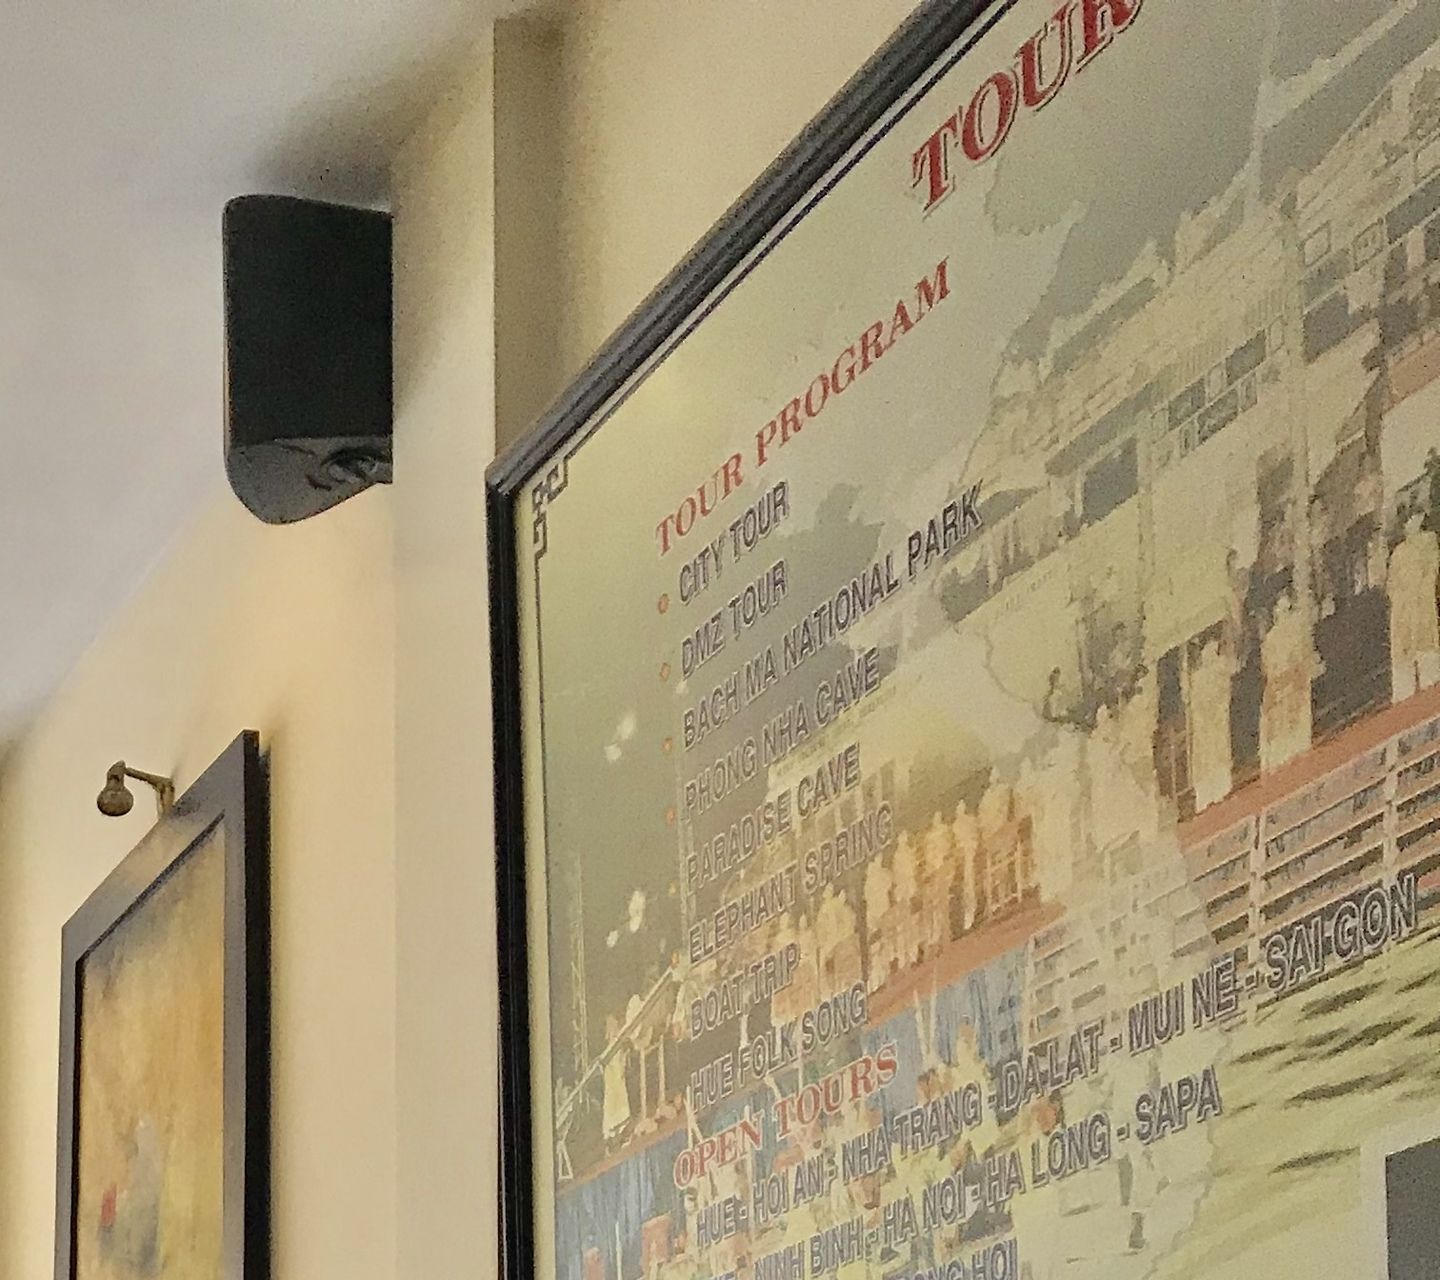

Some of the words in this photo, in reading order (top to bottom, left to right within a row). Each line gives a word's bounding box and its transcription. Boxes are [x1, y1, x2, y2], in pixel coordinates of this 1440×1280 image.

[912, 0, 1142, 218] TOUR
[656, 452, 744, 556] TOUR
[755, 256, 951, 468] PROGRAM
[678, 537, 724, 606] CITY
[728, 480, 790, 563] TOUR
[681, 608, 726, 681] DMZ
[729, 558, 789, 641] TOUR
[683, 671, 741, 751] BACH
[744, 648, 778, 705] MA
[782, 551, 902, 678] NATIONAL
[907, 478, 984, 584] PARK
[684, 737, 757, 824] PHONG
[762, 697, 809, 768] NHA
[816, 646, 881, 728] CAVE
[686, 787, 792, 897] PARADISE
[797, 740, 860, 820] CAVE
[687, 860, 800, 968] ELEPHANT
[804, 802, 894, 895] SPRING
[689, 1051, 733, 1115] HUE
[738, 1021, 801, 1088] FOLK
[802, 979, 869, 1056] SONG
[690, 971, 746, 1041] BOAT
[749, 941, 801, 1004] TRIP
[697, 1194, 738, 1249] HUE
[753, 1169, 789, 1223] HOI
[841, 1122, 892, 1187] NHA
[893, 1080, 983, 1160] TRANG
[1128, 981, 1185, 1057] MUI
[1192, 955, 1239, 1028] NE
[1332, 873, 1418, 963] GON
[672, 1116, 763, 1191] OPEN
[773, 1040, 900, 1141] TOURS
[809, 1214, 864, 1279] BINH
[883, 1194, 919, 1248] HA
[922, 1170, 966, 1233] NOI
[985, 1149, 1026, 1207] HA
[1031, 1111, 1110, 1188] LONG
[1135, 1064, 1223, 1145] SAPA
